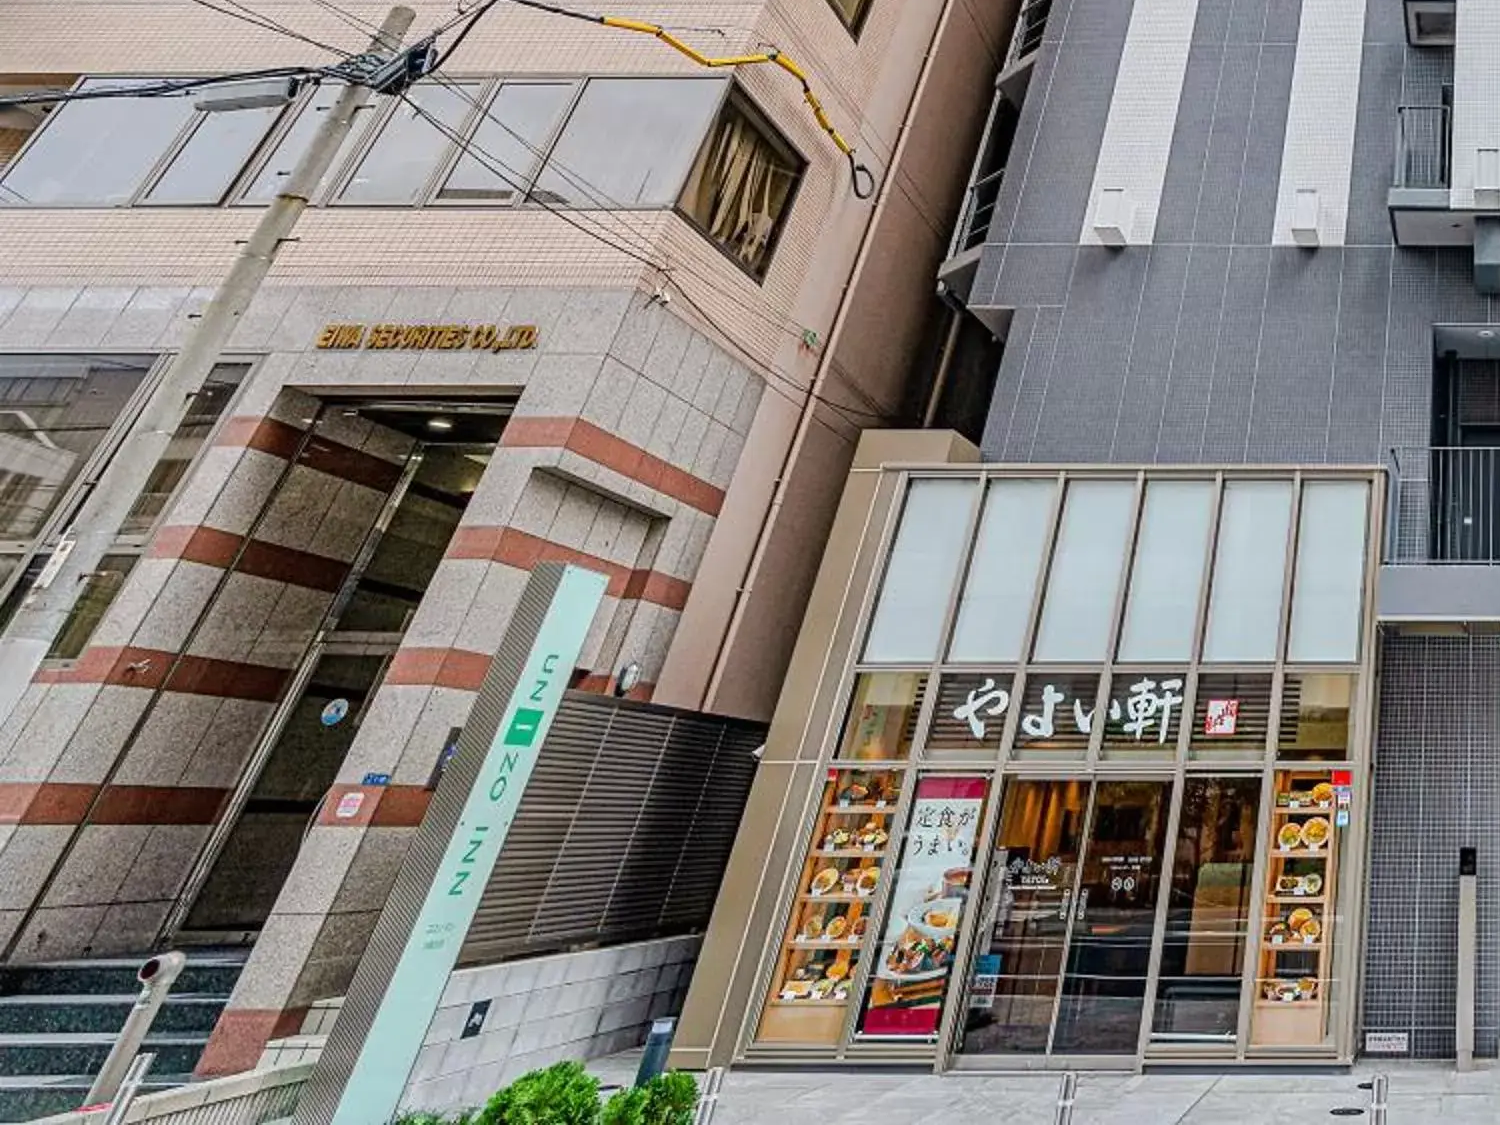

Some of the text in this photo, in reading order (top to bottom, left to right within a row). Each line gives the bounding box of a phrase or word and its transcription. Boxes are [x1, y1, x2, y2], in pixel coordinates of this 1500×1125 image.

[316, 325, 364, 349] EIWA
[367, 324, 470, 349] SECURITIES
[953, 677, 1184, 744] やよい軒
[448, 654, 560, 895] UNIZO INN
